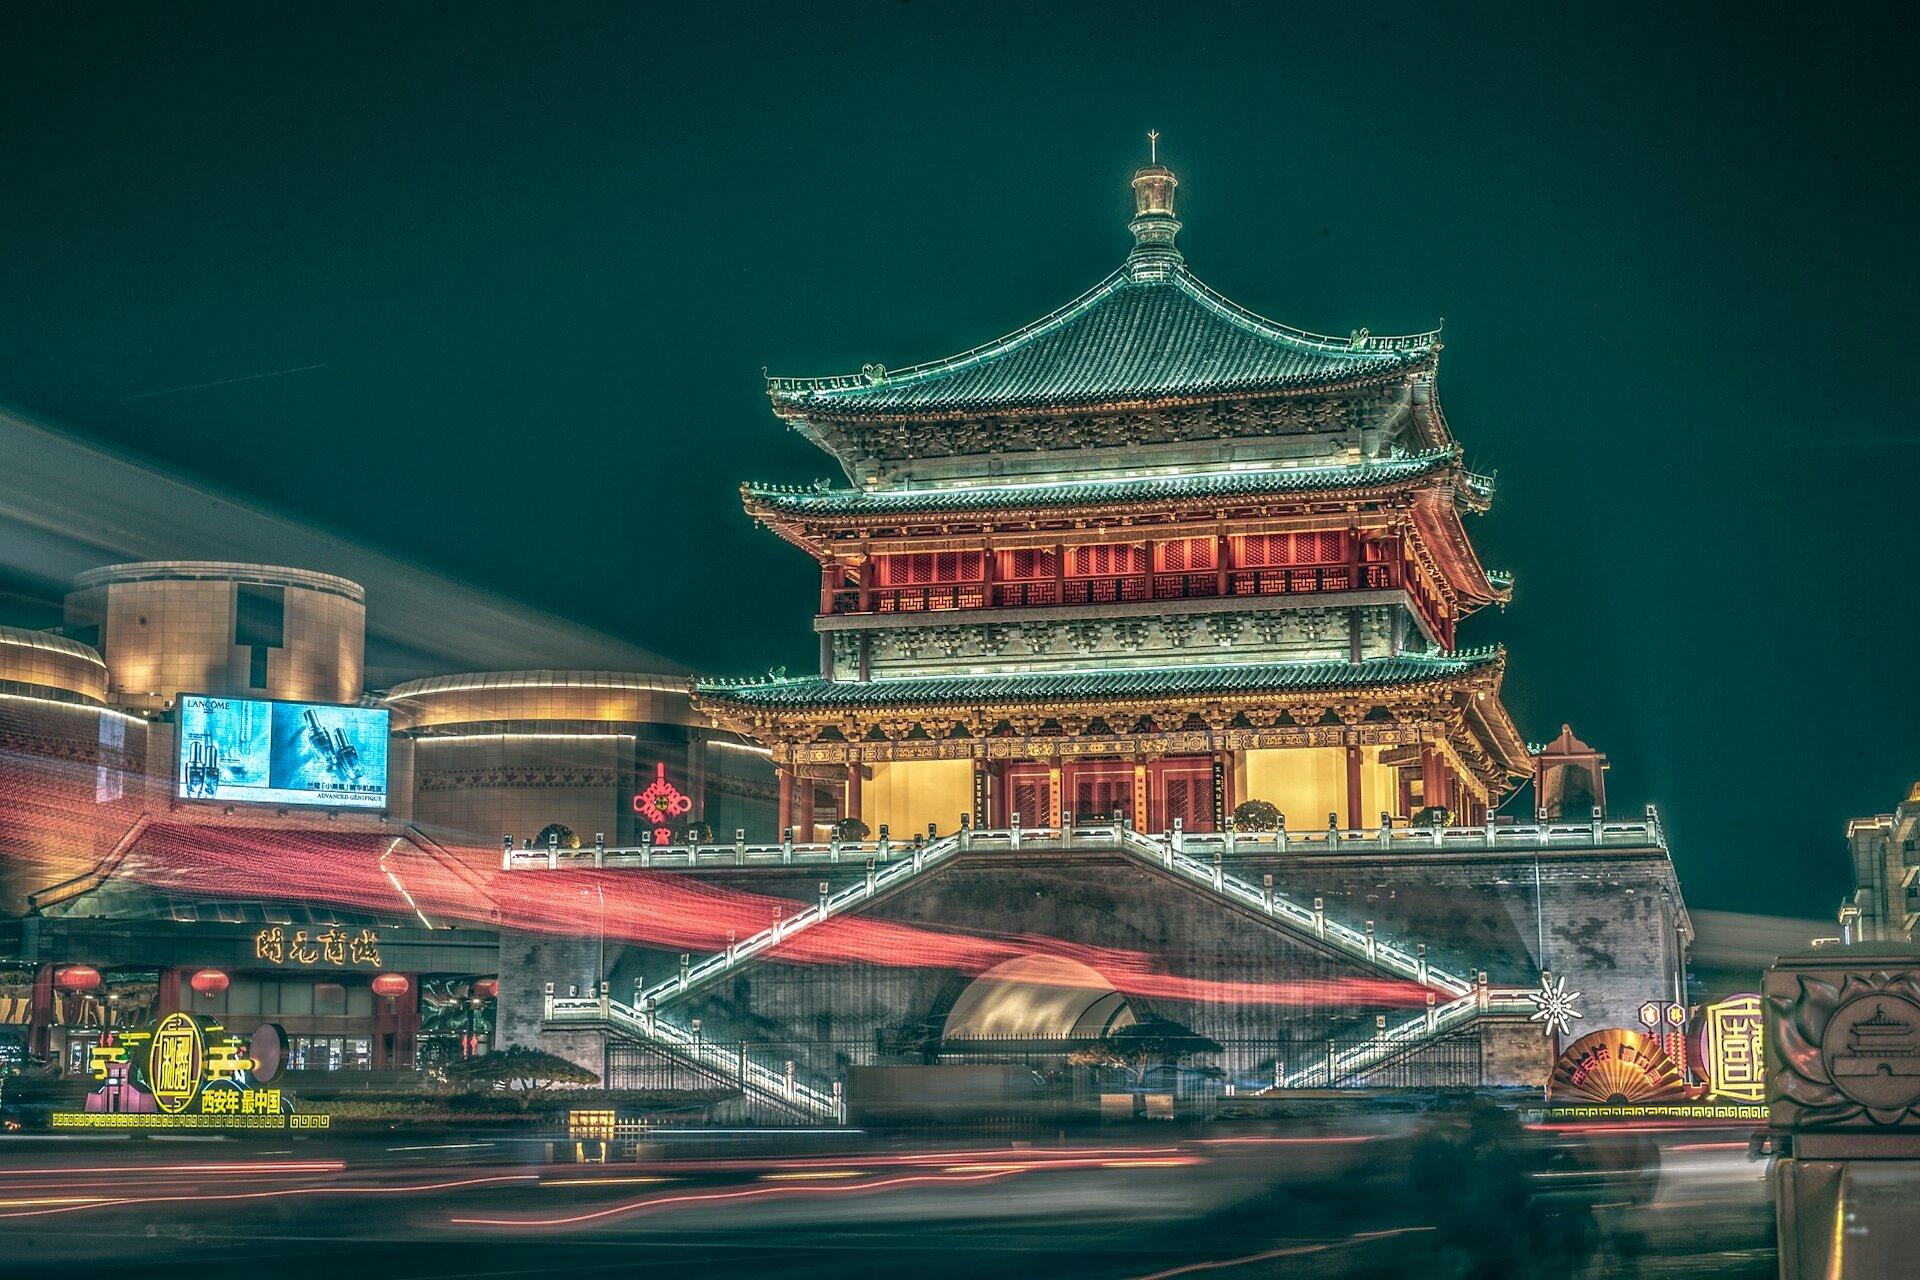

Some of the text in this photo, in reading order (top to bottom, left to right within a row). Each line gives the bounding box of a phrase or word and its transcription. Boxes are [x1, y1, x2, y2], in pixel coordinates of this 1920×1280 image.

[202, 1088, 280, 1114] 西安年 最中国
